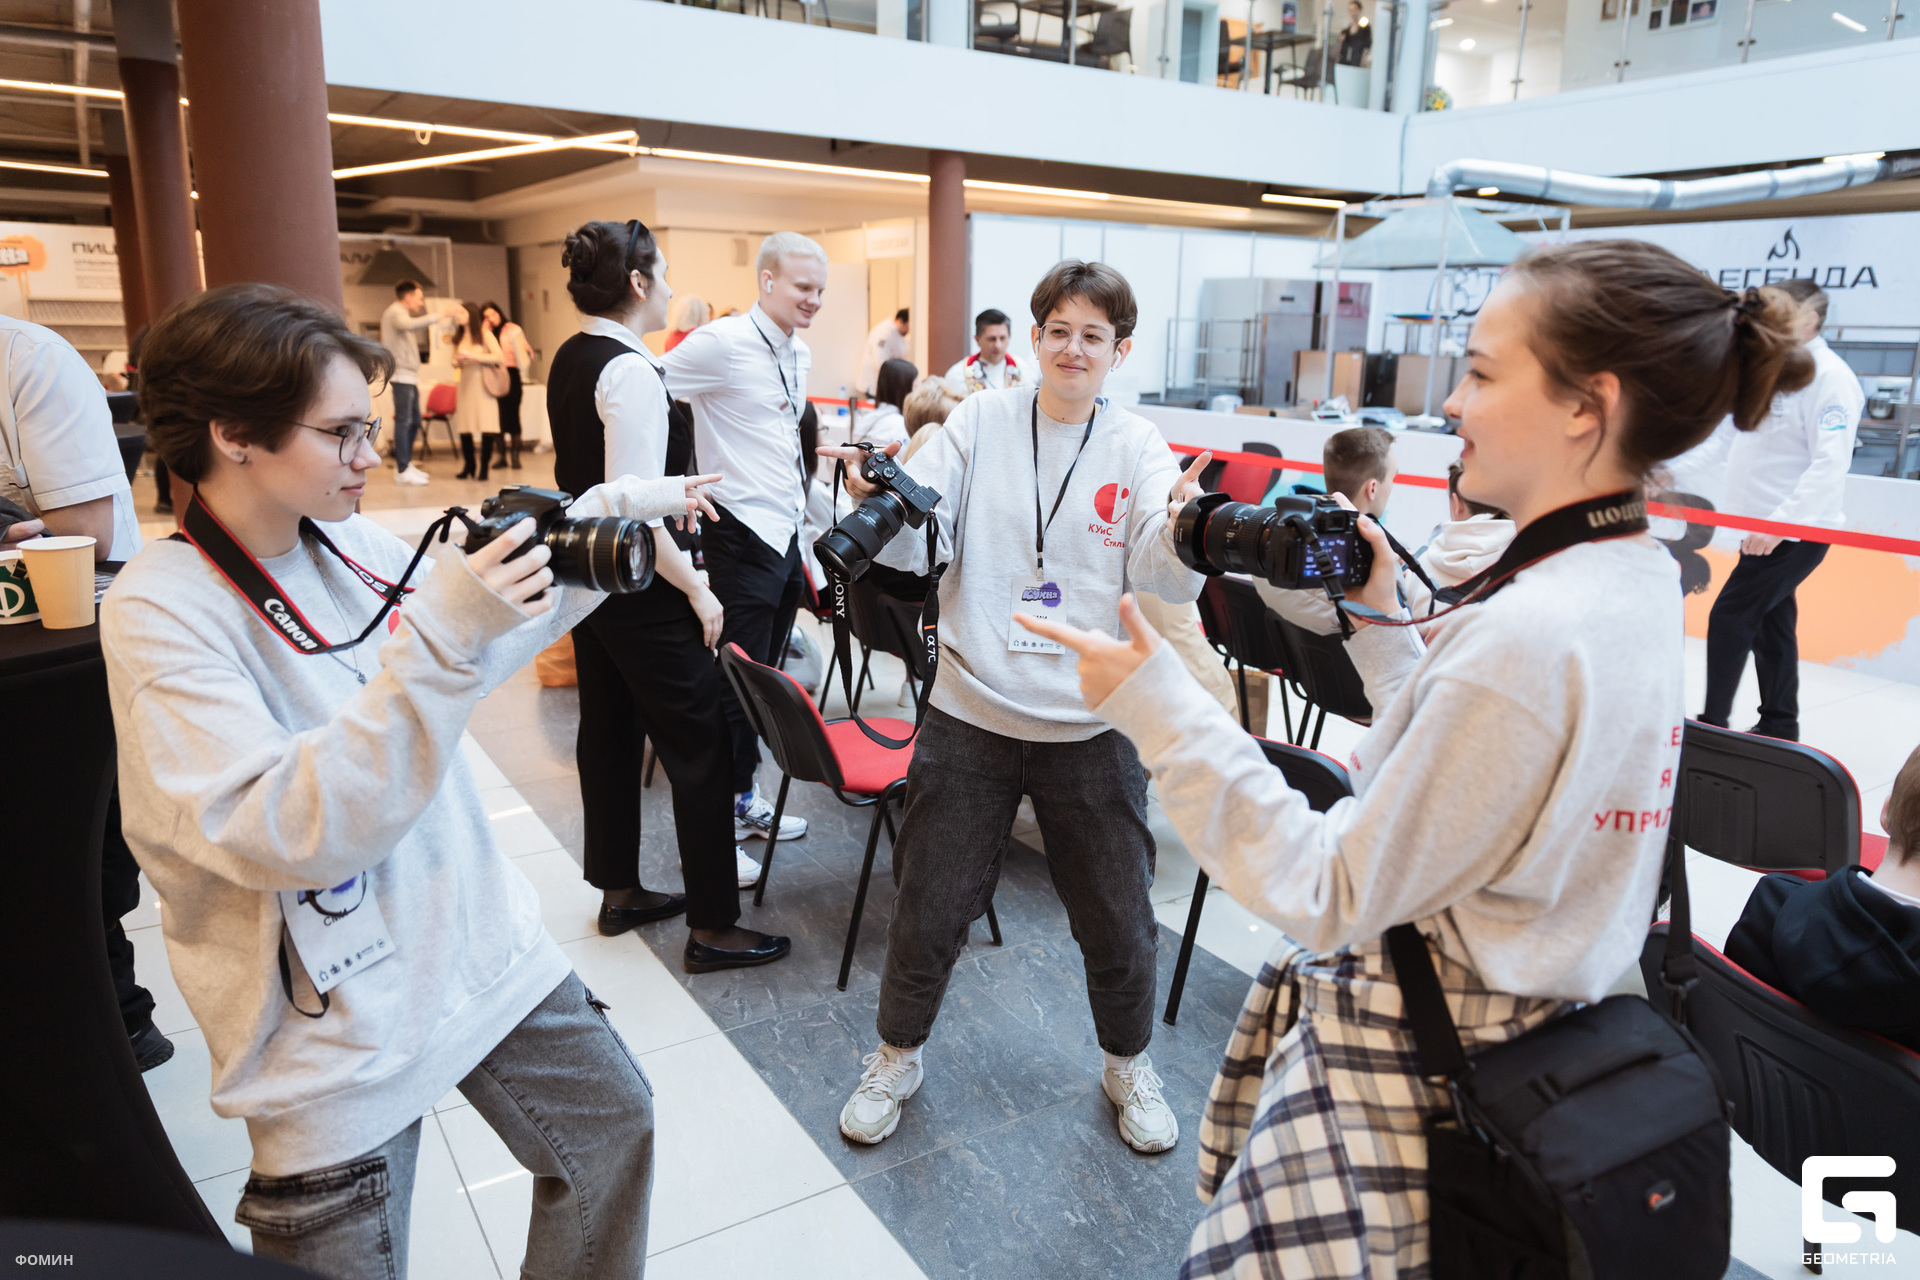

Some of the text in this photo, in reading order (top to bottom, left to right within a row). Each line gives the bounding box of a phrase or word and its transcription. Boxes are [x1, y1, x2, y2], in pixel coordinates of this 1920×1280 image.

[1704, 266, 1879, 290] ЕГЕНДА
[835, 579, 846, 618] ONY
[264, 598, 318, 650] Canon
